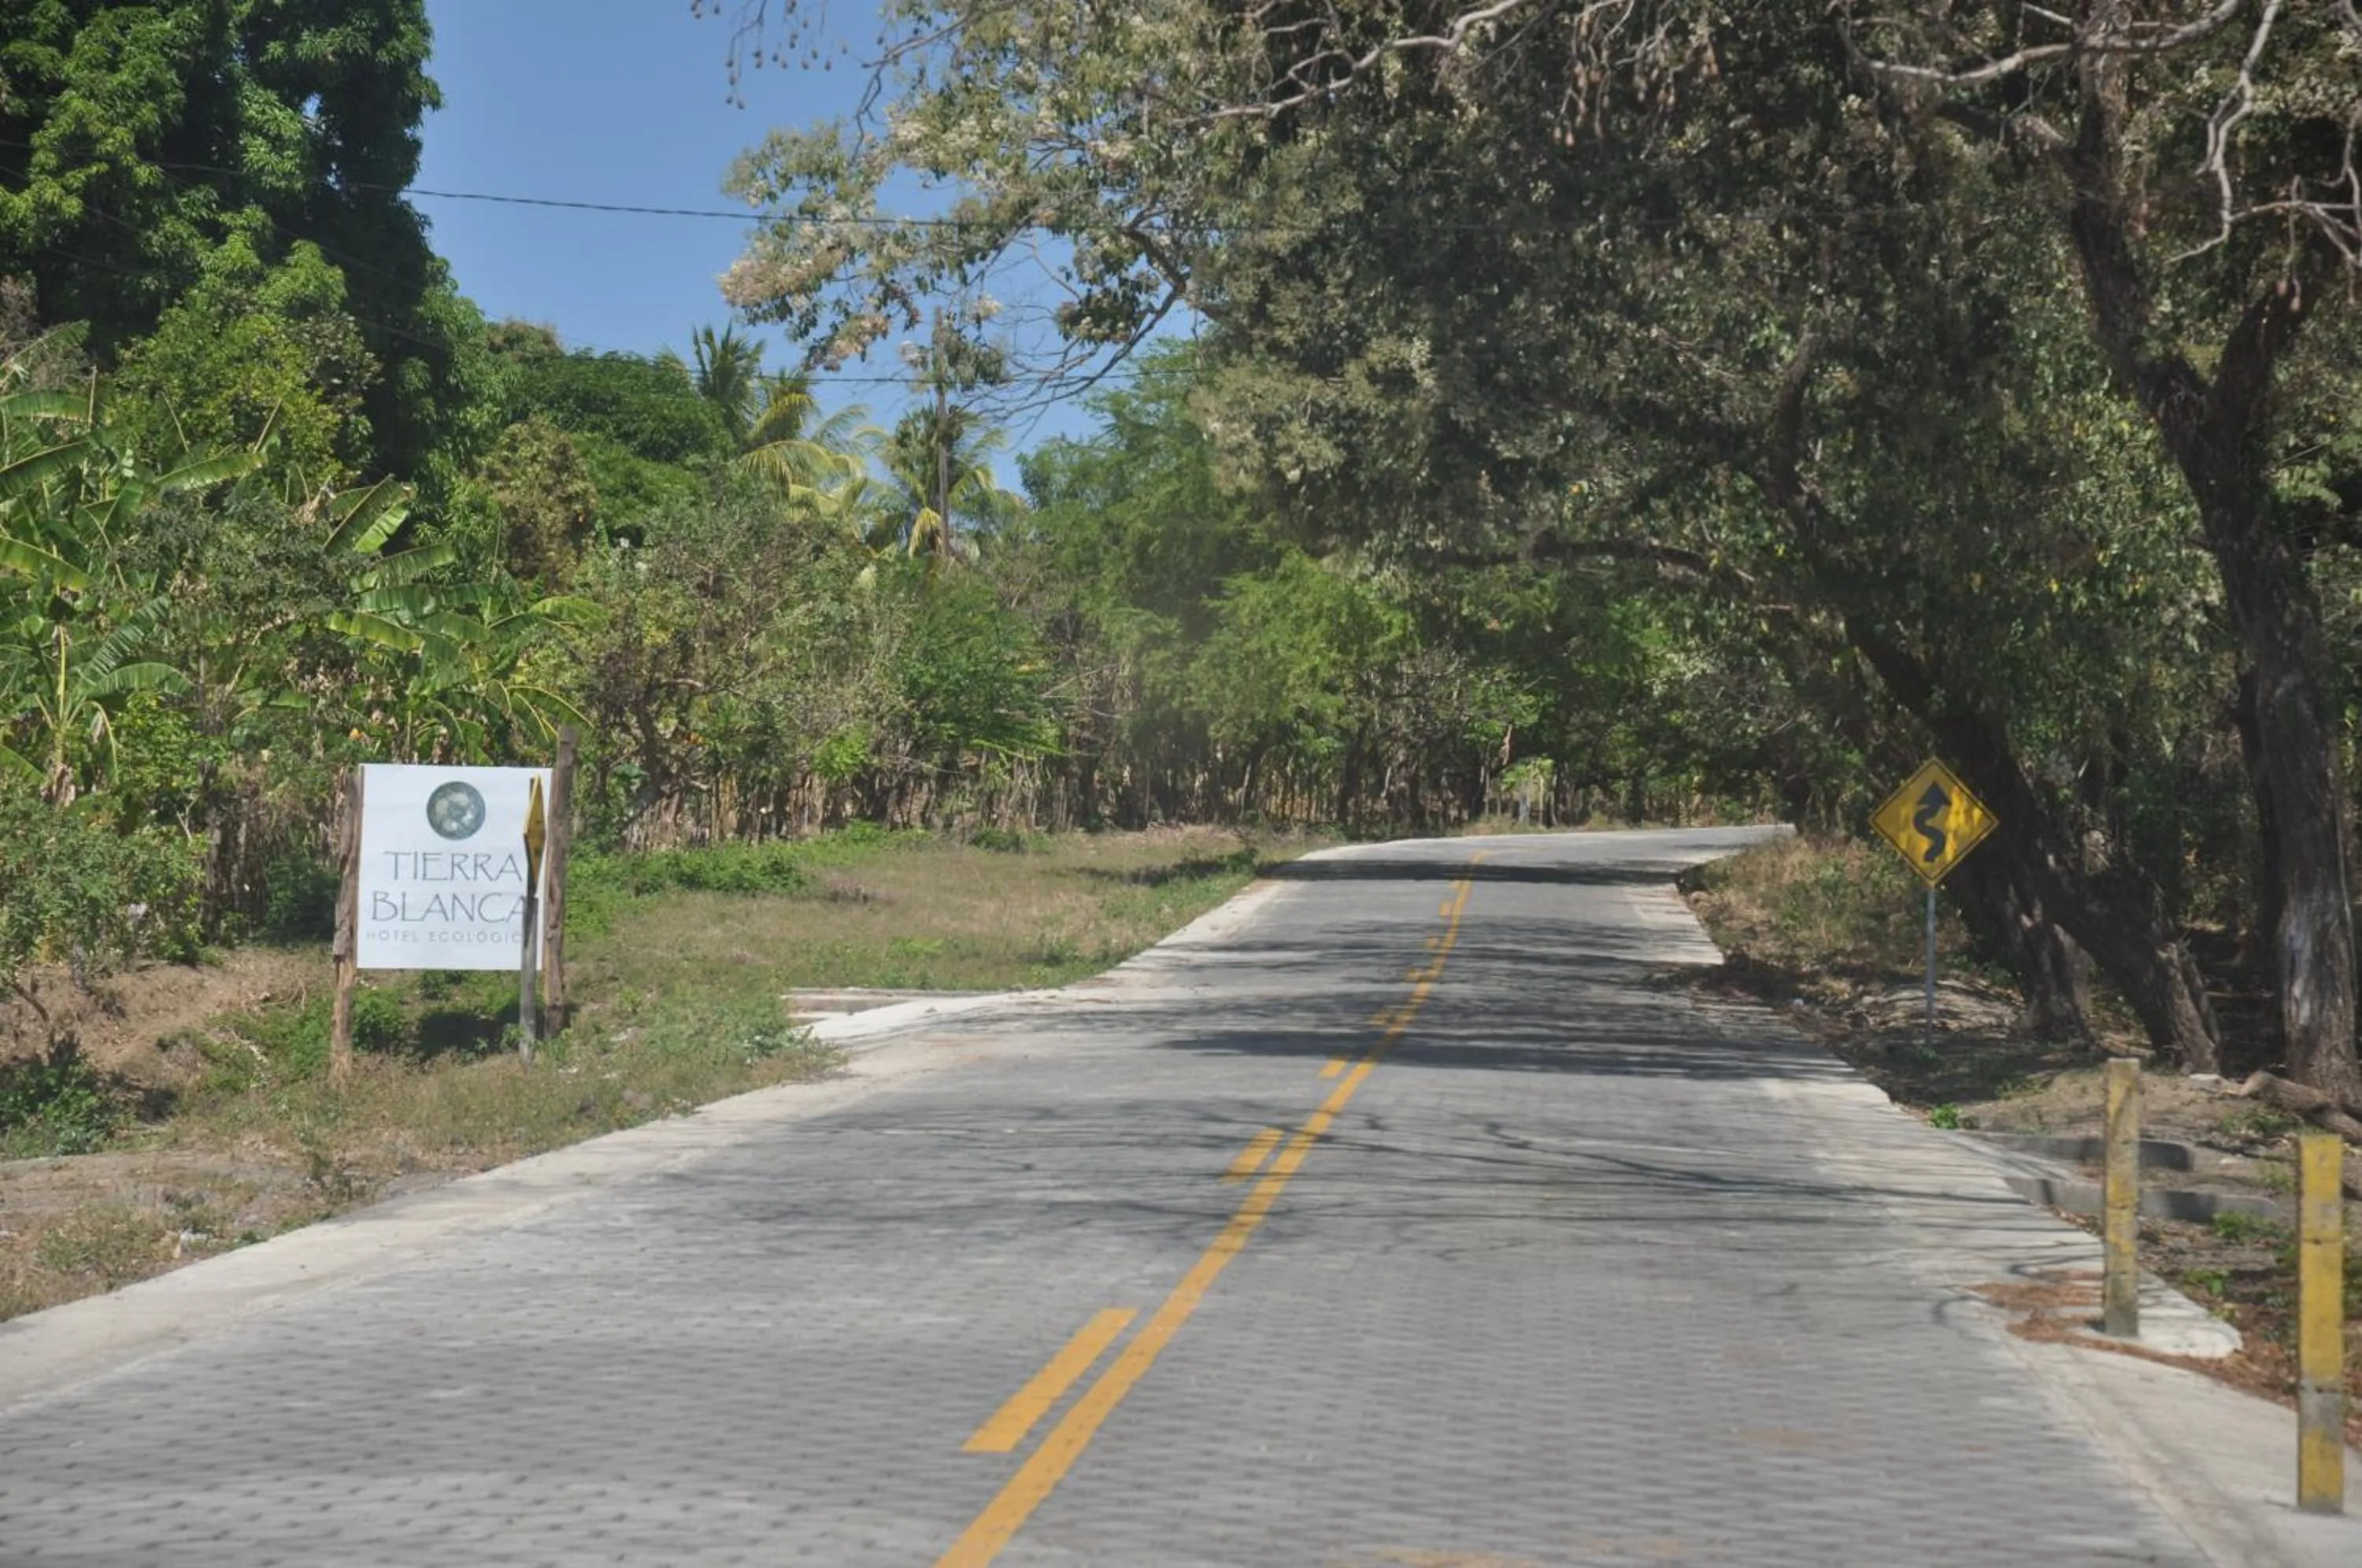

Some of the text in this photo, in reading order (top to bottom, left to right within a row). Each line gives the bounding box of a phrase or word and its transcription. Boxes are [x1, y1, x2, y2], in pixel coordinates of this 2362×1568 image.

[384, 851, 523, 882] TIERRA
[372, 890, 525, 923] BLANCA
[366, 930, 523, 943] HOTEL ECOLOGIC
